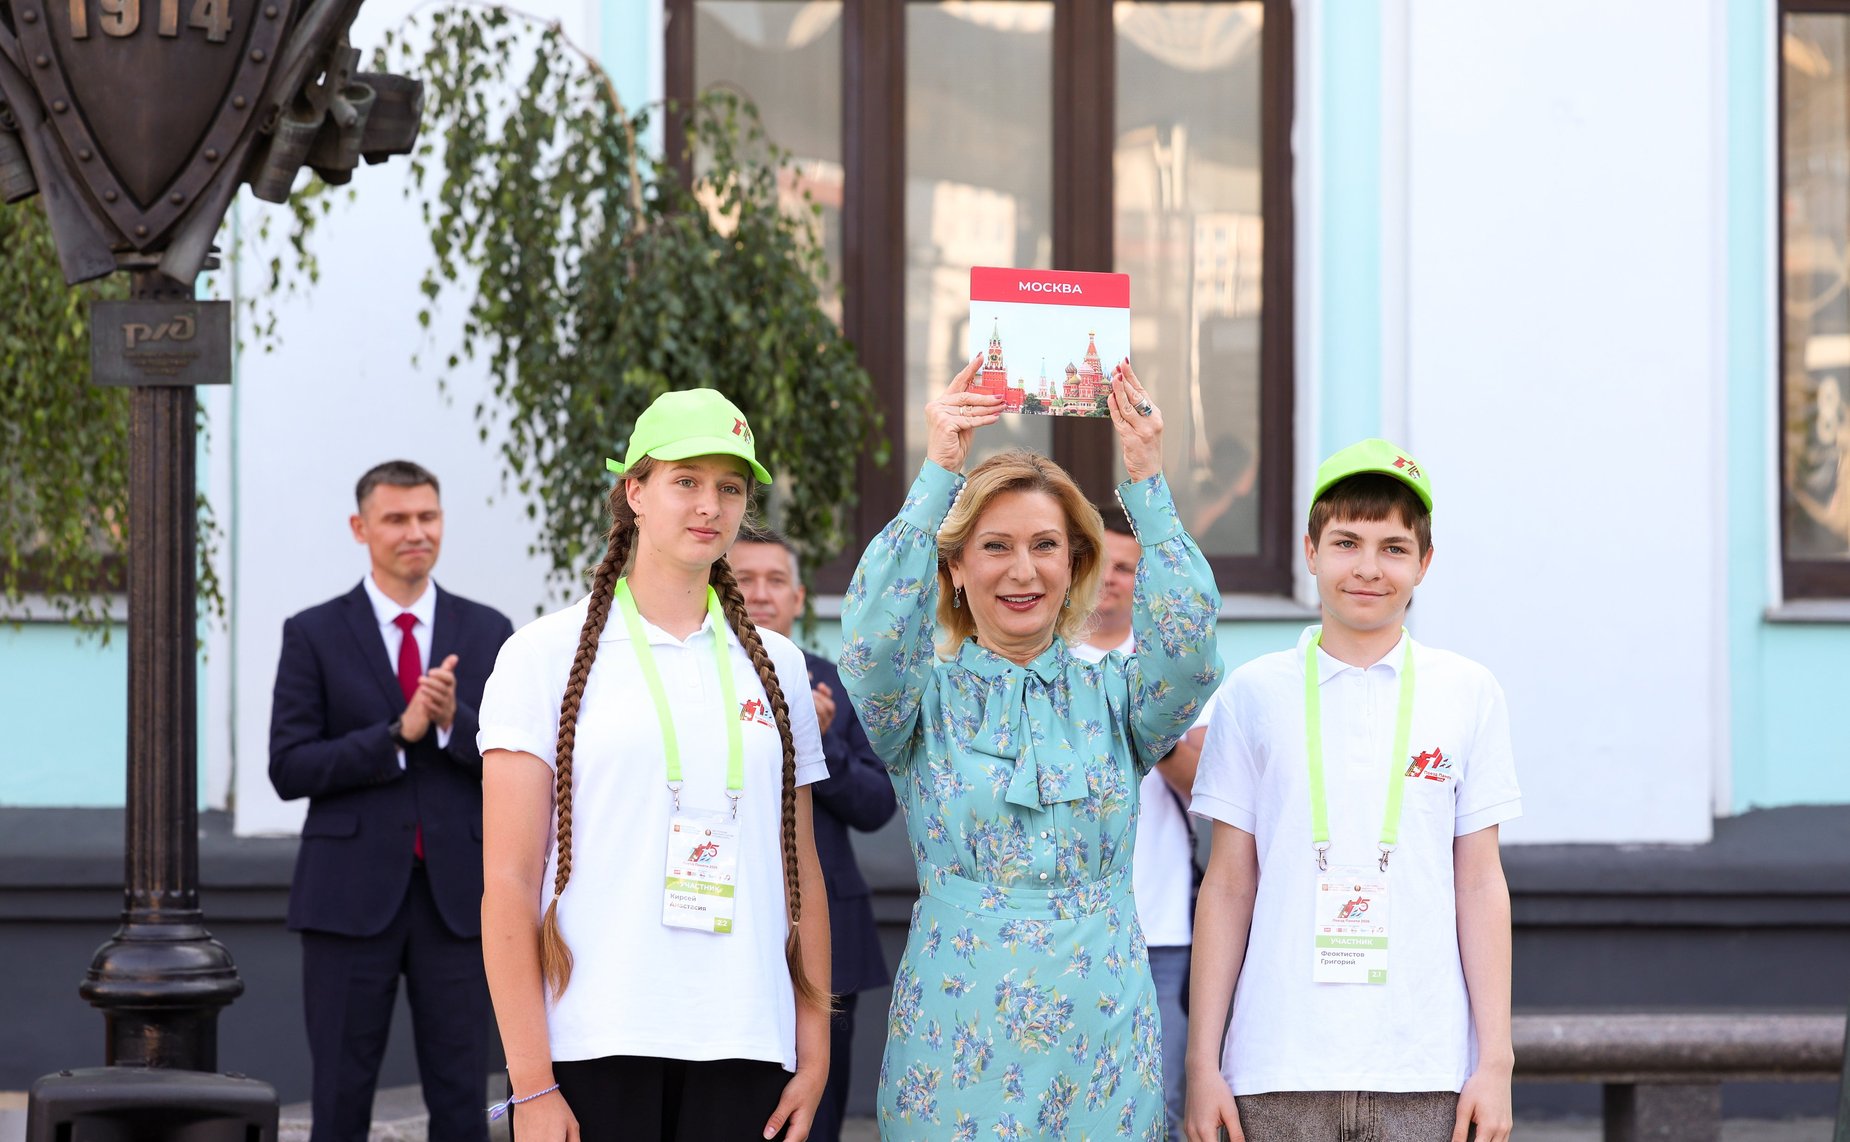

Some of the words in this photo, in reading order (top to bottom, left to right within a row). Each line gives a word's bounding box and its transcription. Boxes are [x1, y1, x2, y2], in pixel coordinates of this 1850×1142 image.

[1018, 281, 1083, 294] МОСКВА
[680, 881, 721, 892] УЧАСТНИК
[670, 893, 697, 902] Кирсей
[669, 902, 707, 911] Анастасия
[1331, 937, 1373, 945] УЧАСТНИК
